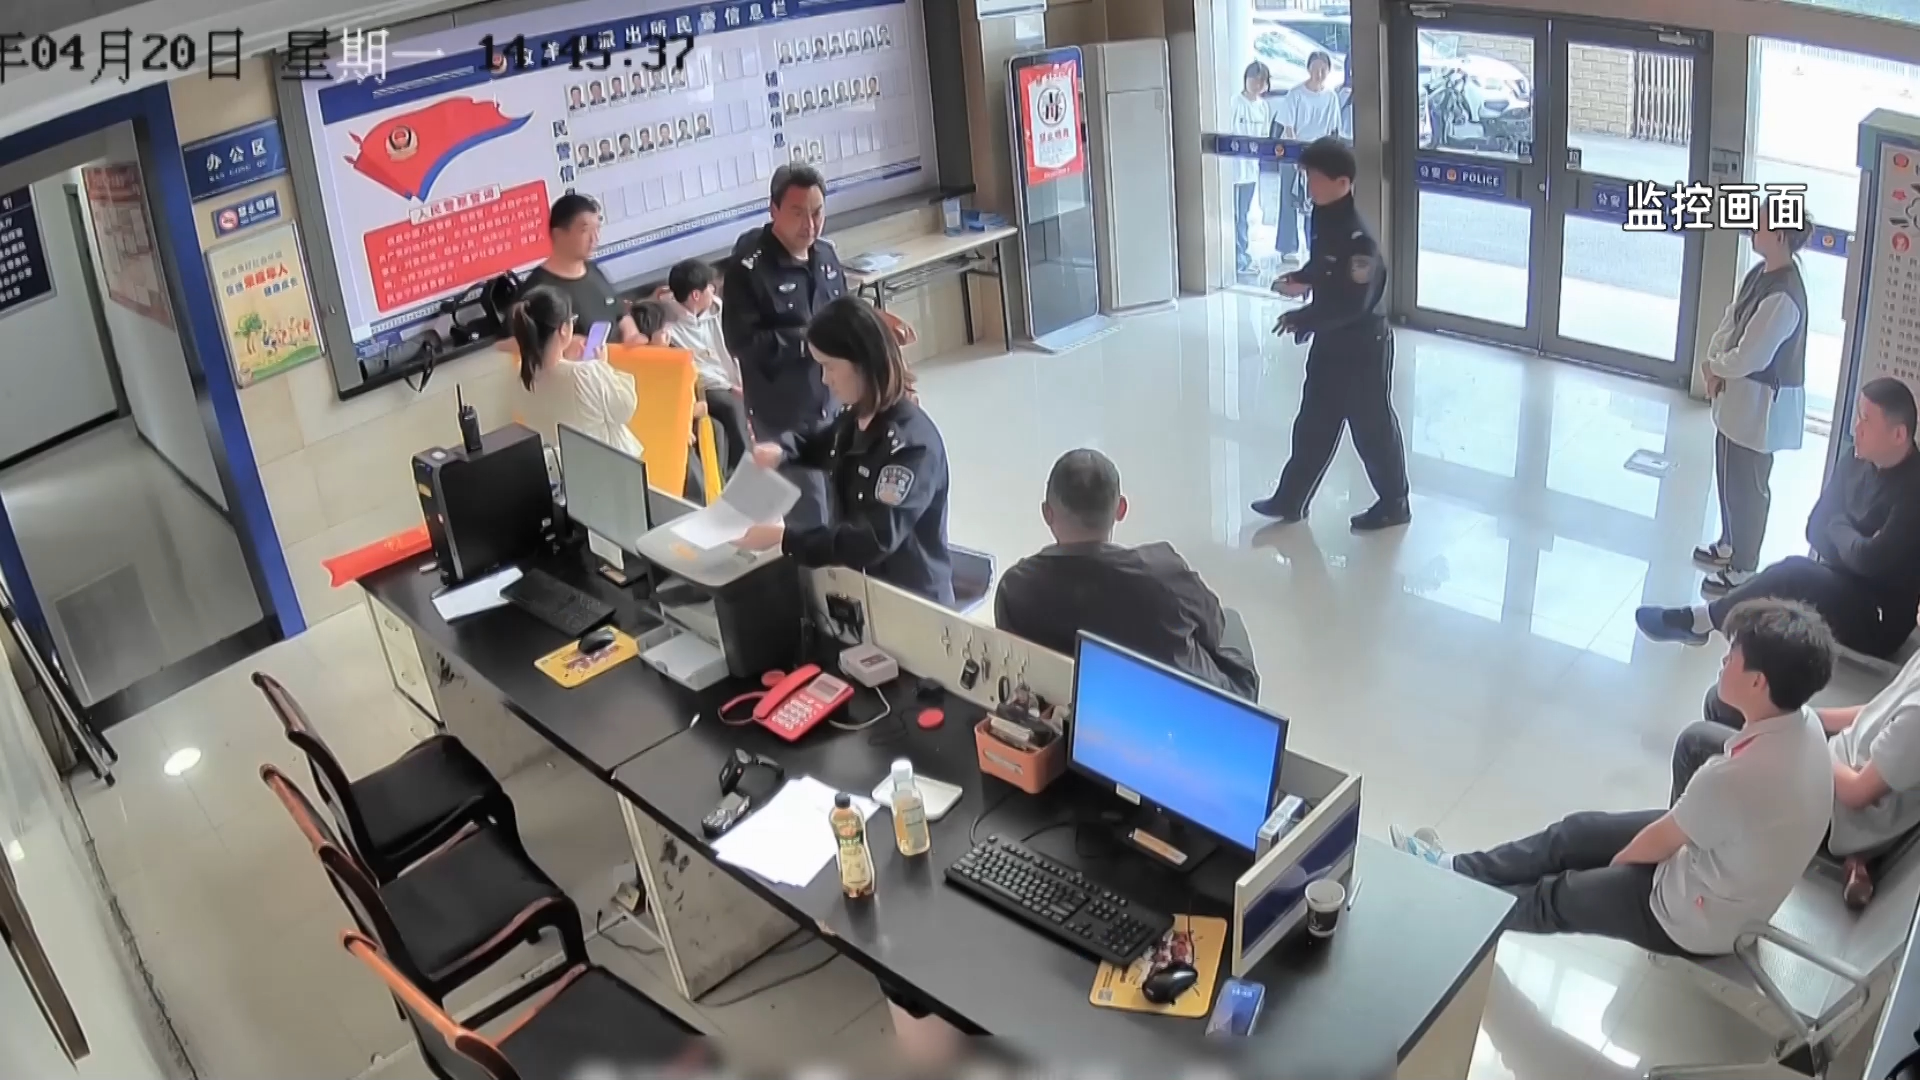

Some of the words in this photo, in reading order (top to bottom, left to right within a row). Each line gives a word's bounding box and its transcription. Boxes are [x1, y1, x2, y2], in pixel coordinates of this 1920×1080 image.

[206, 137, 266, 171] 办公区
[1462, 171, 1499, 187] POLICE
